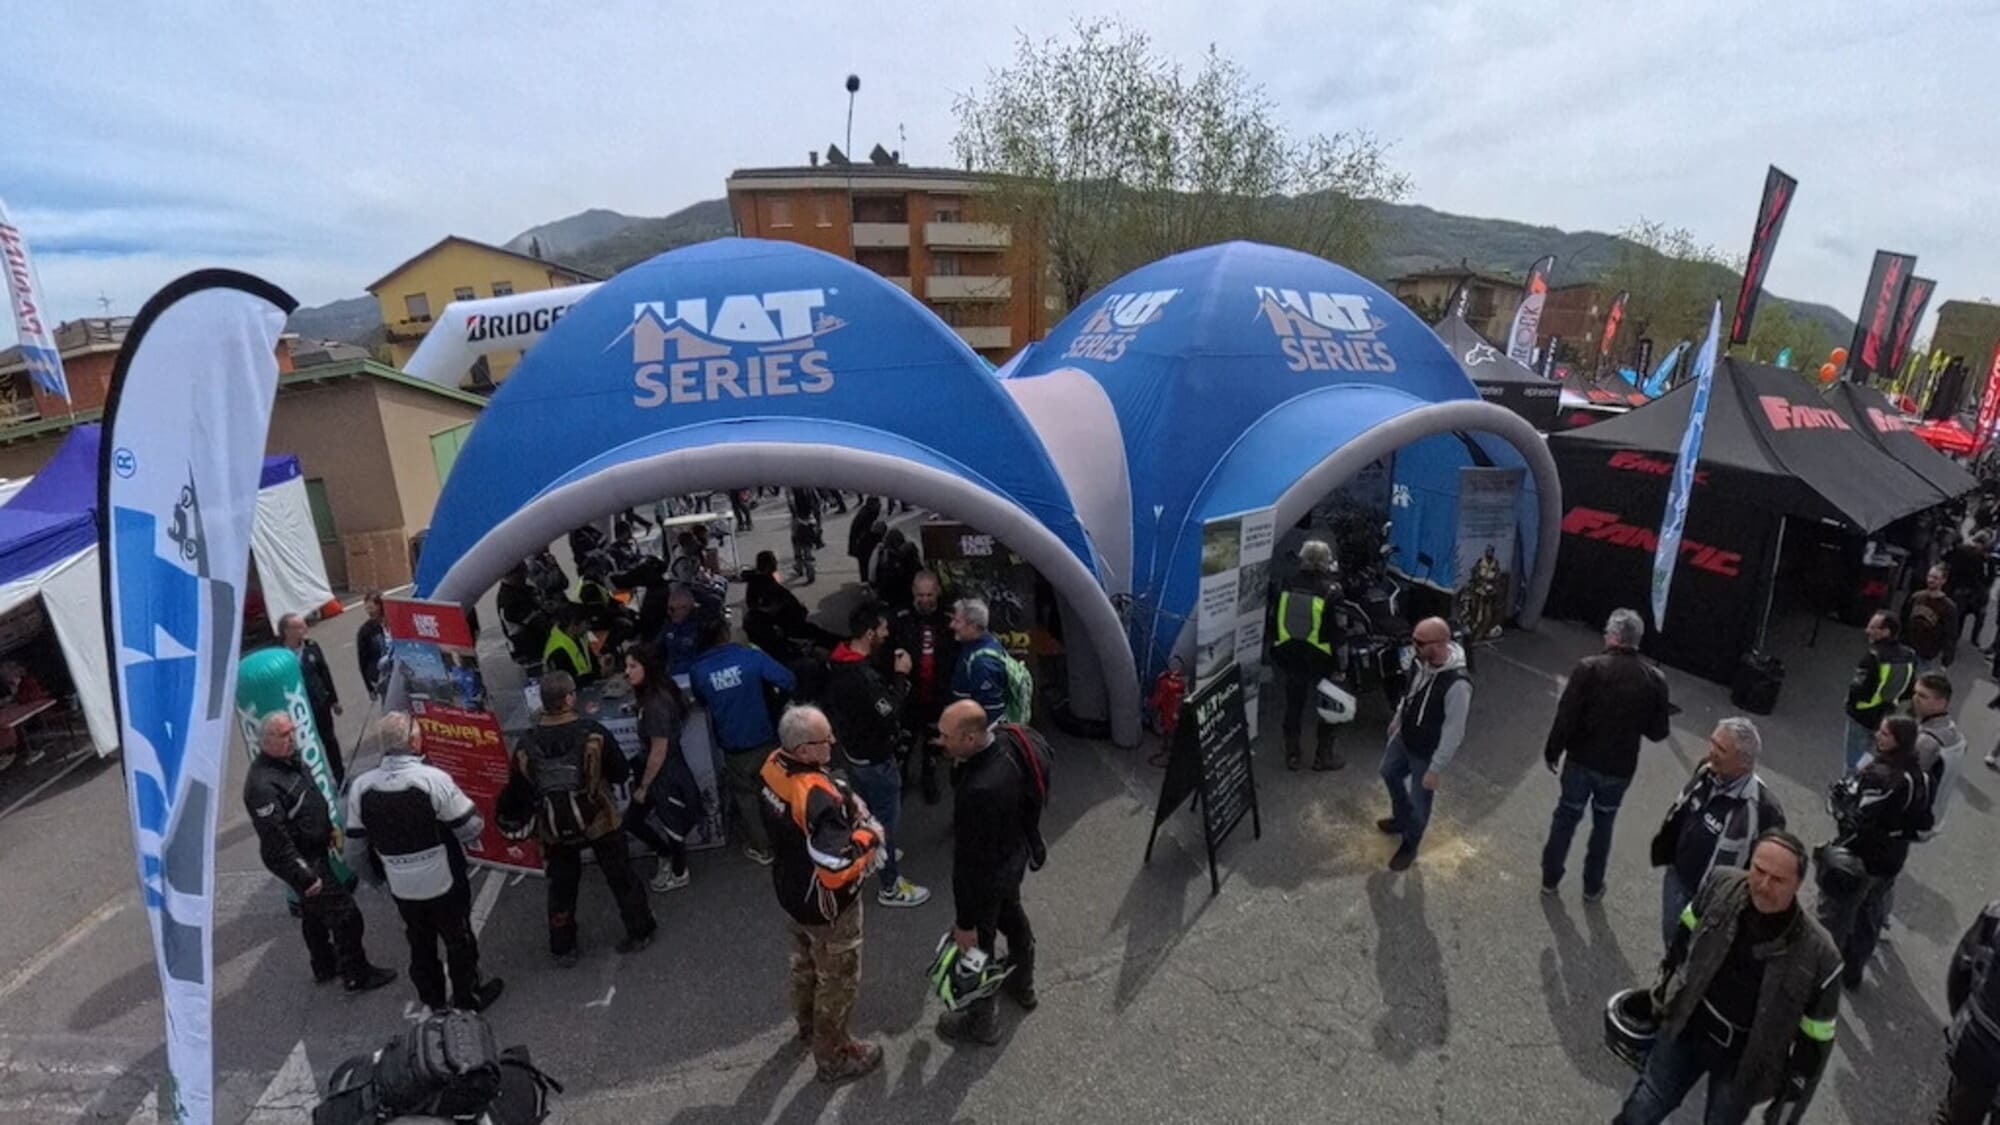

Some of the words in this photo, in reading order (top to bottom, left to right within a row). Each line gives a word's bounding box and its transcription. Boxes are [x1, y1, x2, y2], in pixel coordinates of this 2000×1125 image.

[466, 304, 574, 342] BRIDGE
[1061, 334, 1138, 362] SERIES
[1281, 336, 1397, 373] SERIES
[633, 350, 835, 408] SERIES
[1561, 506, 1742, 577] FANIC
